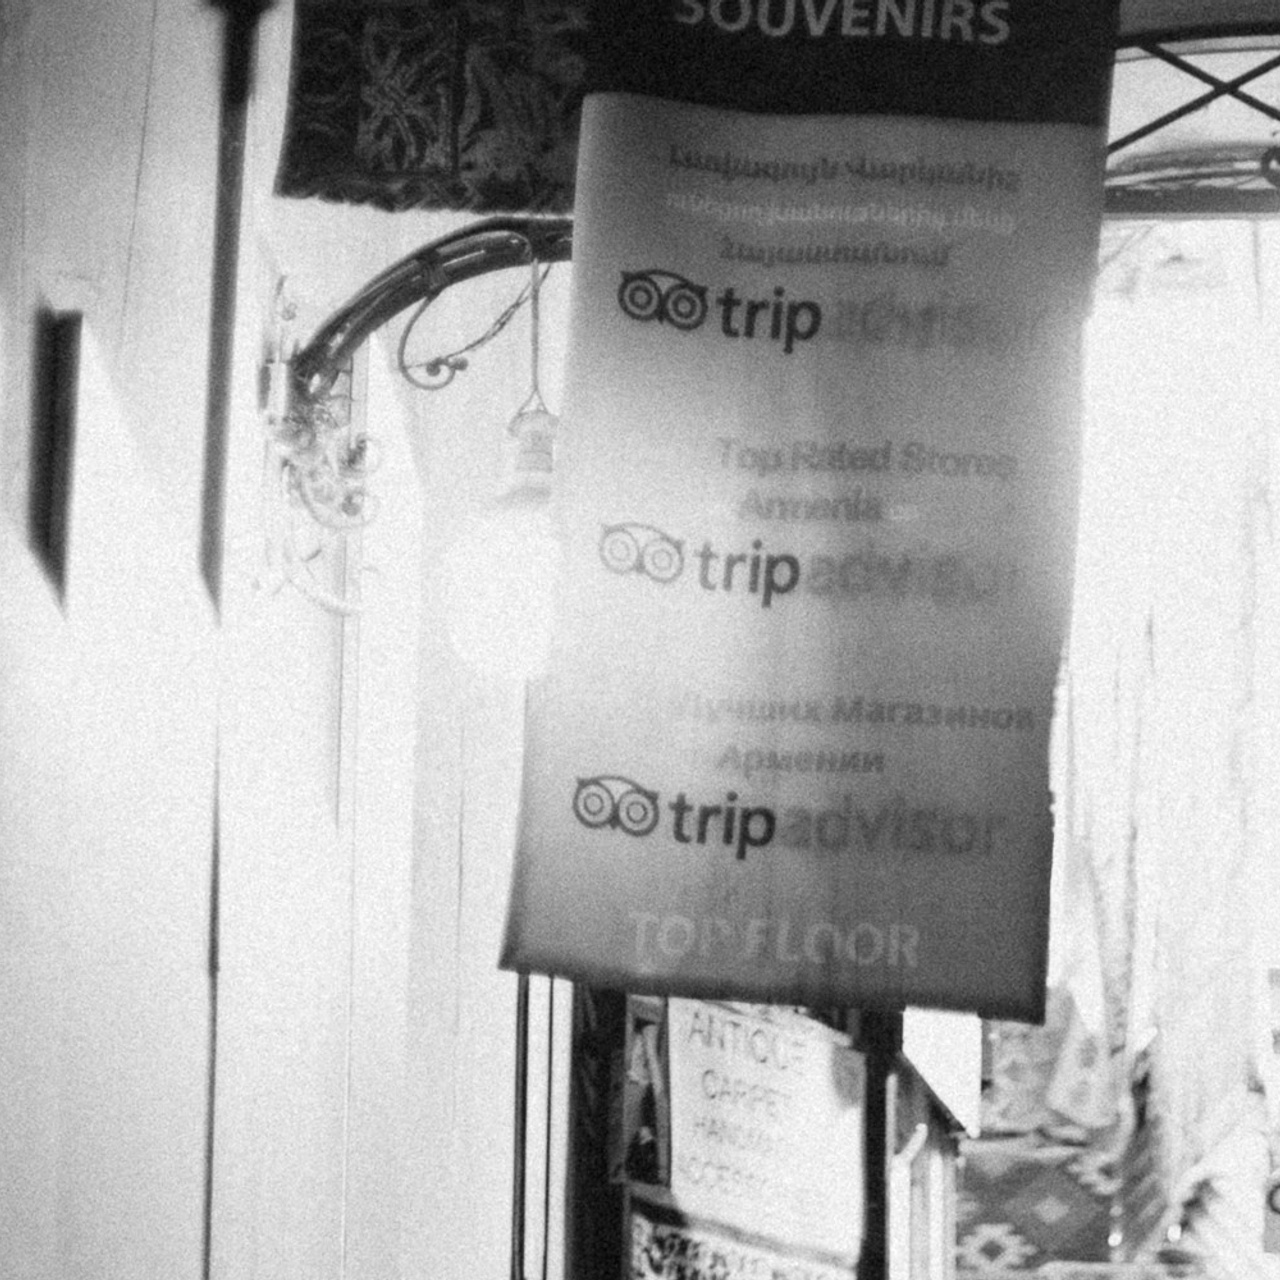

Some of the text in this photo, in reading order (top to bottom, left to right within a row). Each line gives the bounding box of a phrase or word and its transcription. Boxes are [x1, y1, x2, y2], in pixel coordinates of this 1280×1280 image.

[790, 438, 892, 474] Rated
[628, 910, 736, 960] TOP
[743, 915, 921, 968] FLOOR
